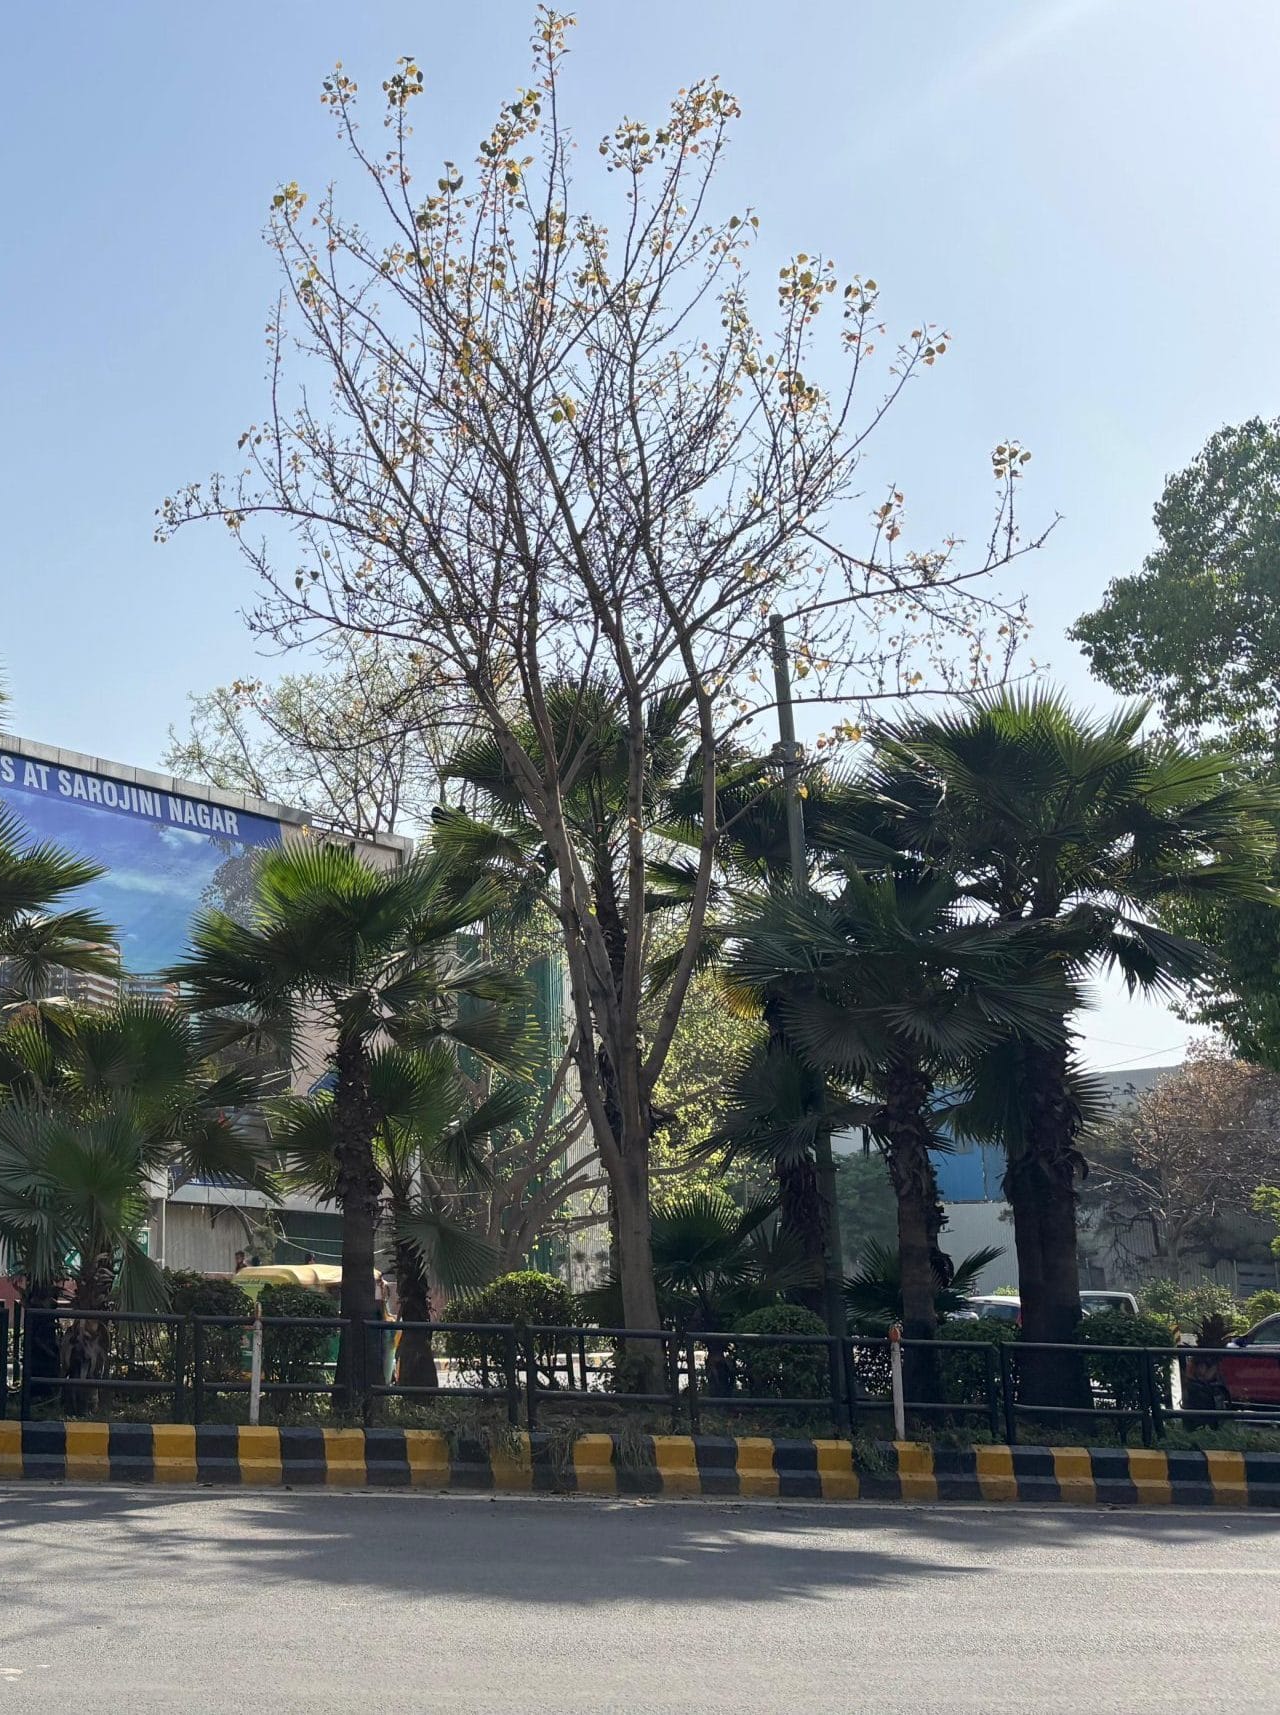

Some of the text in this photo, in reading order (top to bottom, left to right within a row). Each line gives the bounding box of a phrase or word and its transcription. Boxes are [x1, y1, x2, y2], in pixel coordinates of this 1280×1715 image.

[23, 761, 51, 791] AT
[58, 769, 162, 818] SAROJINI
[167, 796, 239, 836] NAGAR
